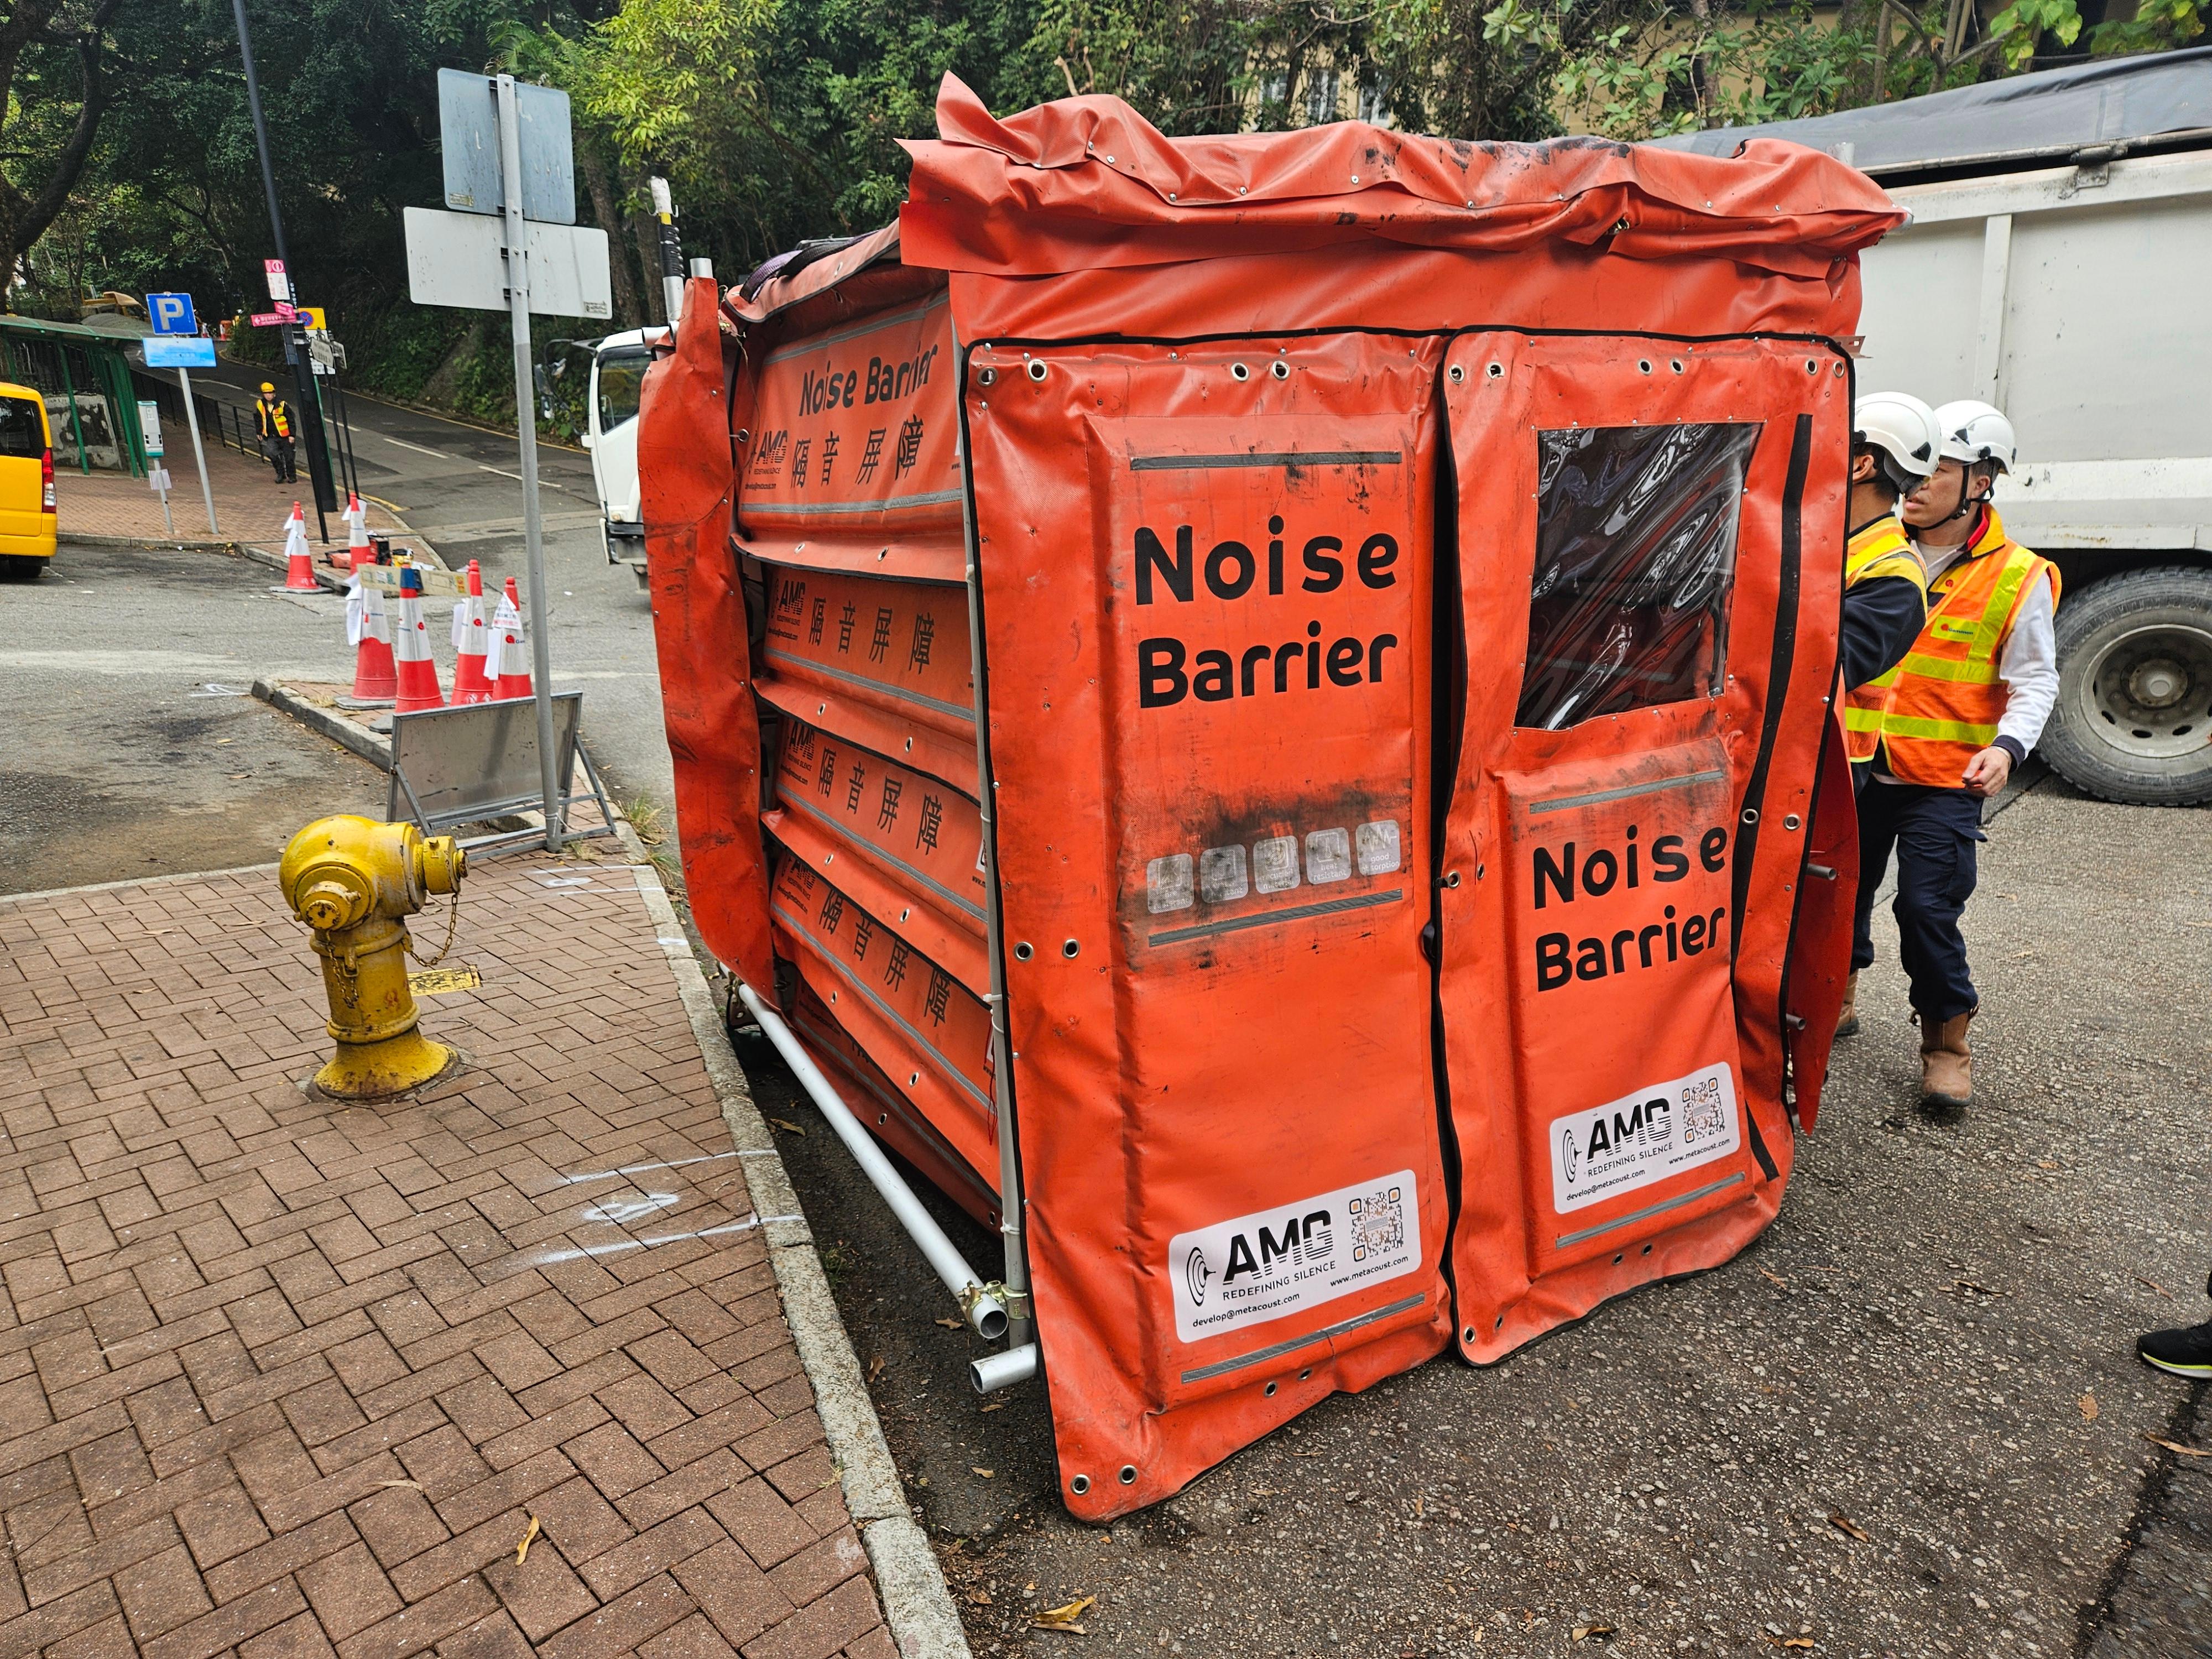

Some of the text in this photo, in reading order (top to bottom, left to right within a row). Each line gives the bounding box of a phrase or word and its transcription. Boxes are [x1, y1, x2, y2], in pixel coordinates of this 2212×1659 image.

[156, 298, 184, 330] P
[799, 341, 938, 416] Noise Barrier
[791, 414, 924, 489] 隔音屏障
[1134, 515, 1399, 606] Noise
[808, 596, 935, 675] 隔音屏障
[1138, 620, 1397, 708] Barrier
[817, 747, 943, 855] 隔音屏障
[1313, 870, 1347, 881] resistant
[1371, 853, 1389, 864] good
[1533, 825, 1727, 910] Noise
[819, 889, 952, 1027] 隔音屏障
[1536, 905, 1725, 992] Barrier
[1588, 1142, 1673, 1177] REDEFINING SILENCE
[1669, 1138, 1730, 1165] www.metacoust.com
[1567, 1168, 1645, 1201] develop@metacoust.com
[1223, 1261, 1336, 1301] REDEFINING SILENCE
[1330, 1255, 1408, 1287] www.metacoust.com
[1193, 1293, 1300, 1327] develop@metacoust.com
